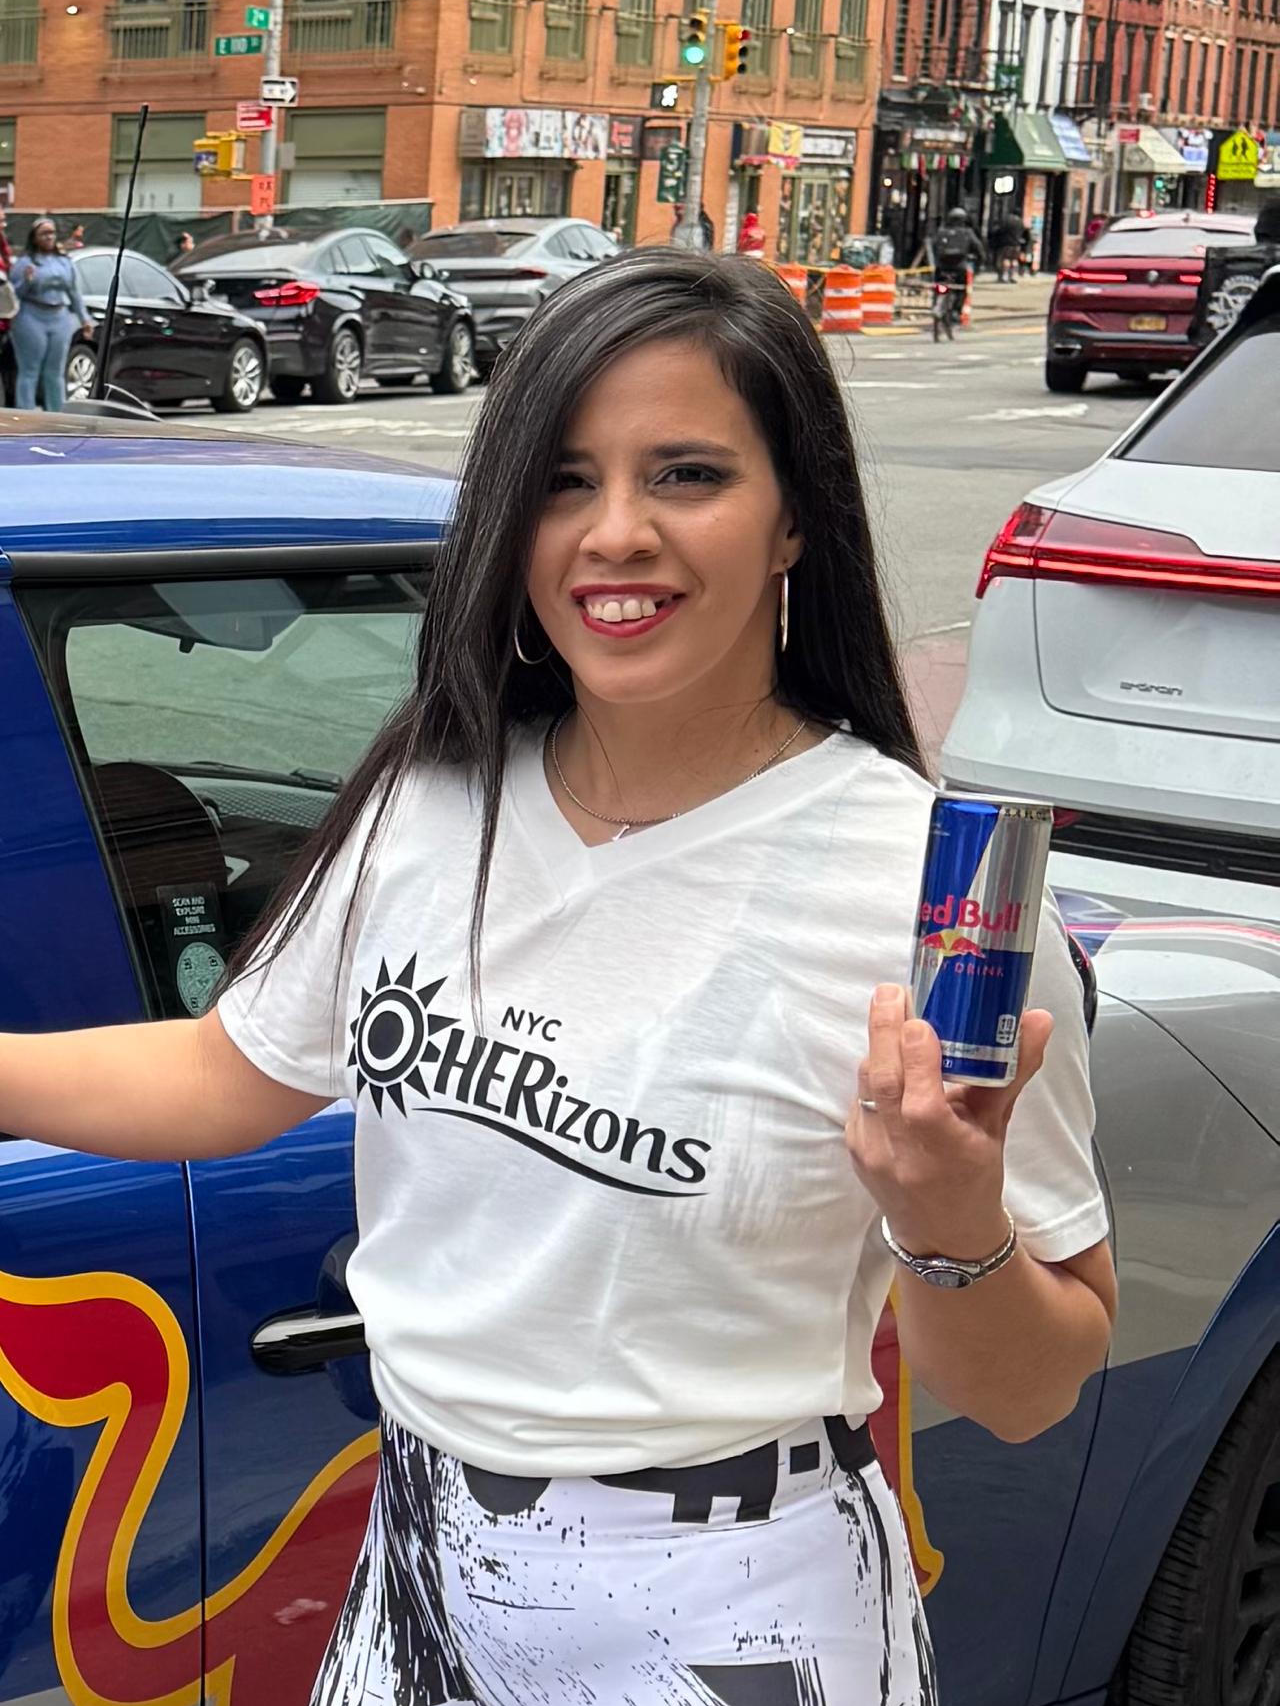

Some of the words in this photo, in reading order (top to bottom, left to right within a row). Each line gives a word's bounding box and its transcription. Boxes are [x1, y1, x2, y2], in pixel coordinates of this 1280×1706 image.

[919, 895, 954, 925] ed
[958, 899, 1022, 933] Bull
[954, 962, 1004, 979] DRINK
[500, 1006, 562, 1041] NYC
